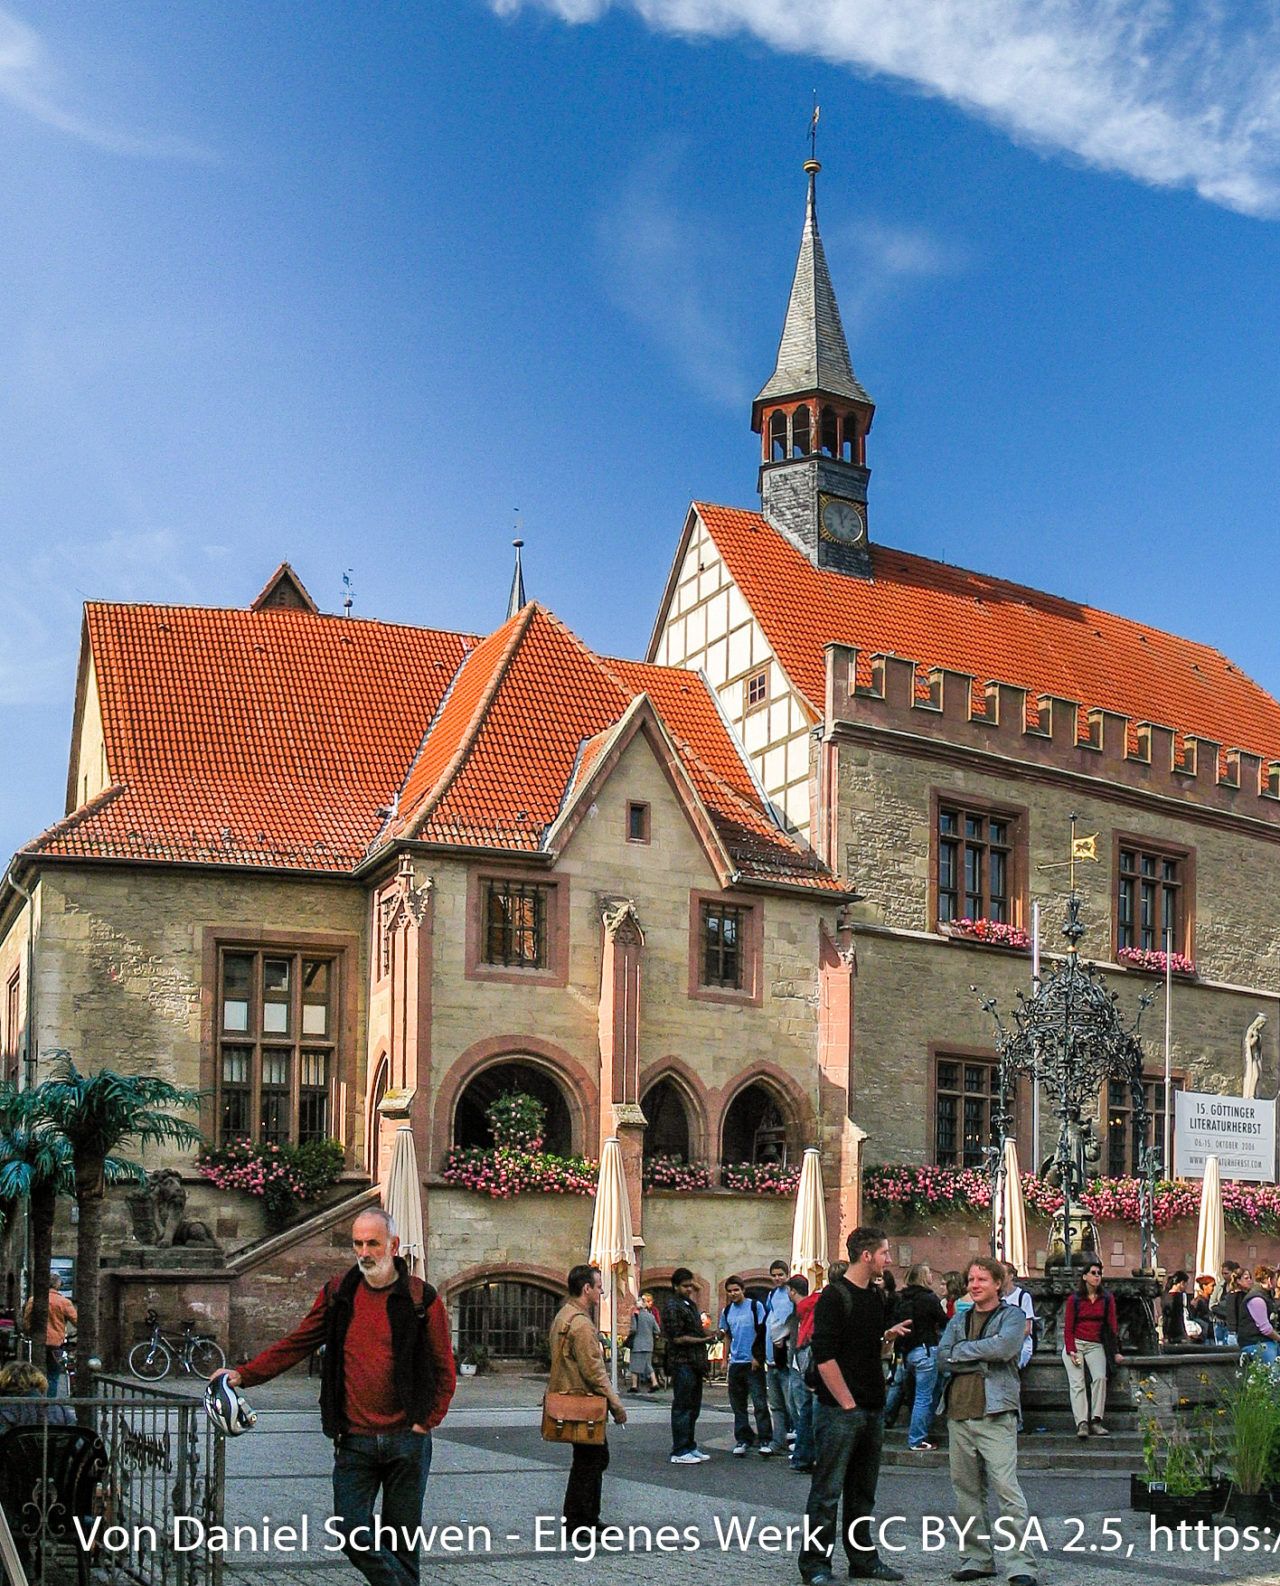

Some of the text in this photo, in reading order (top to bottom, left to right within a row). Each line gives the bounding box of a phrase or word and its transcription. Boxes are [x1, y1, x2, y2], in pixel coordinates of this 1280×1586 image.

[1196, 1103, 1255, 1119] 15. GÖTTINGER
[1189, 1118, 1262, 1134] LITERATURHERBST
[1215, 1140, 1239, 1150] OKTOBER
